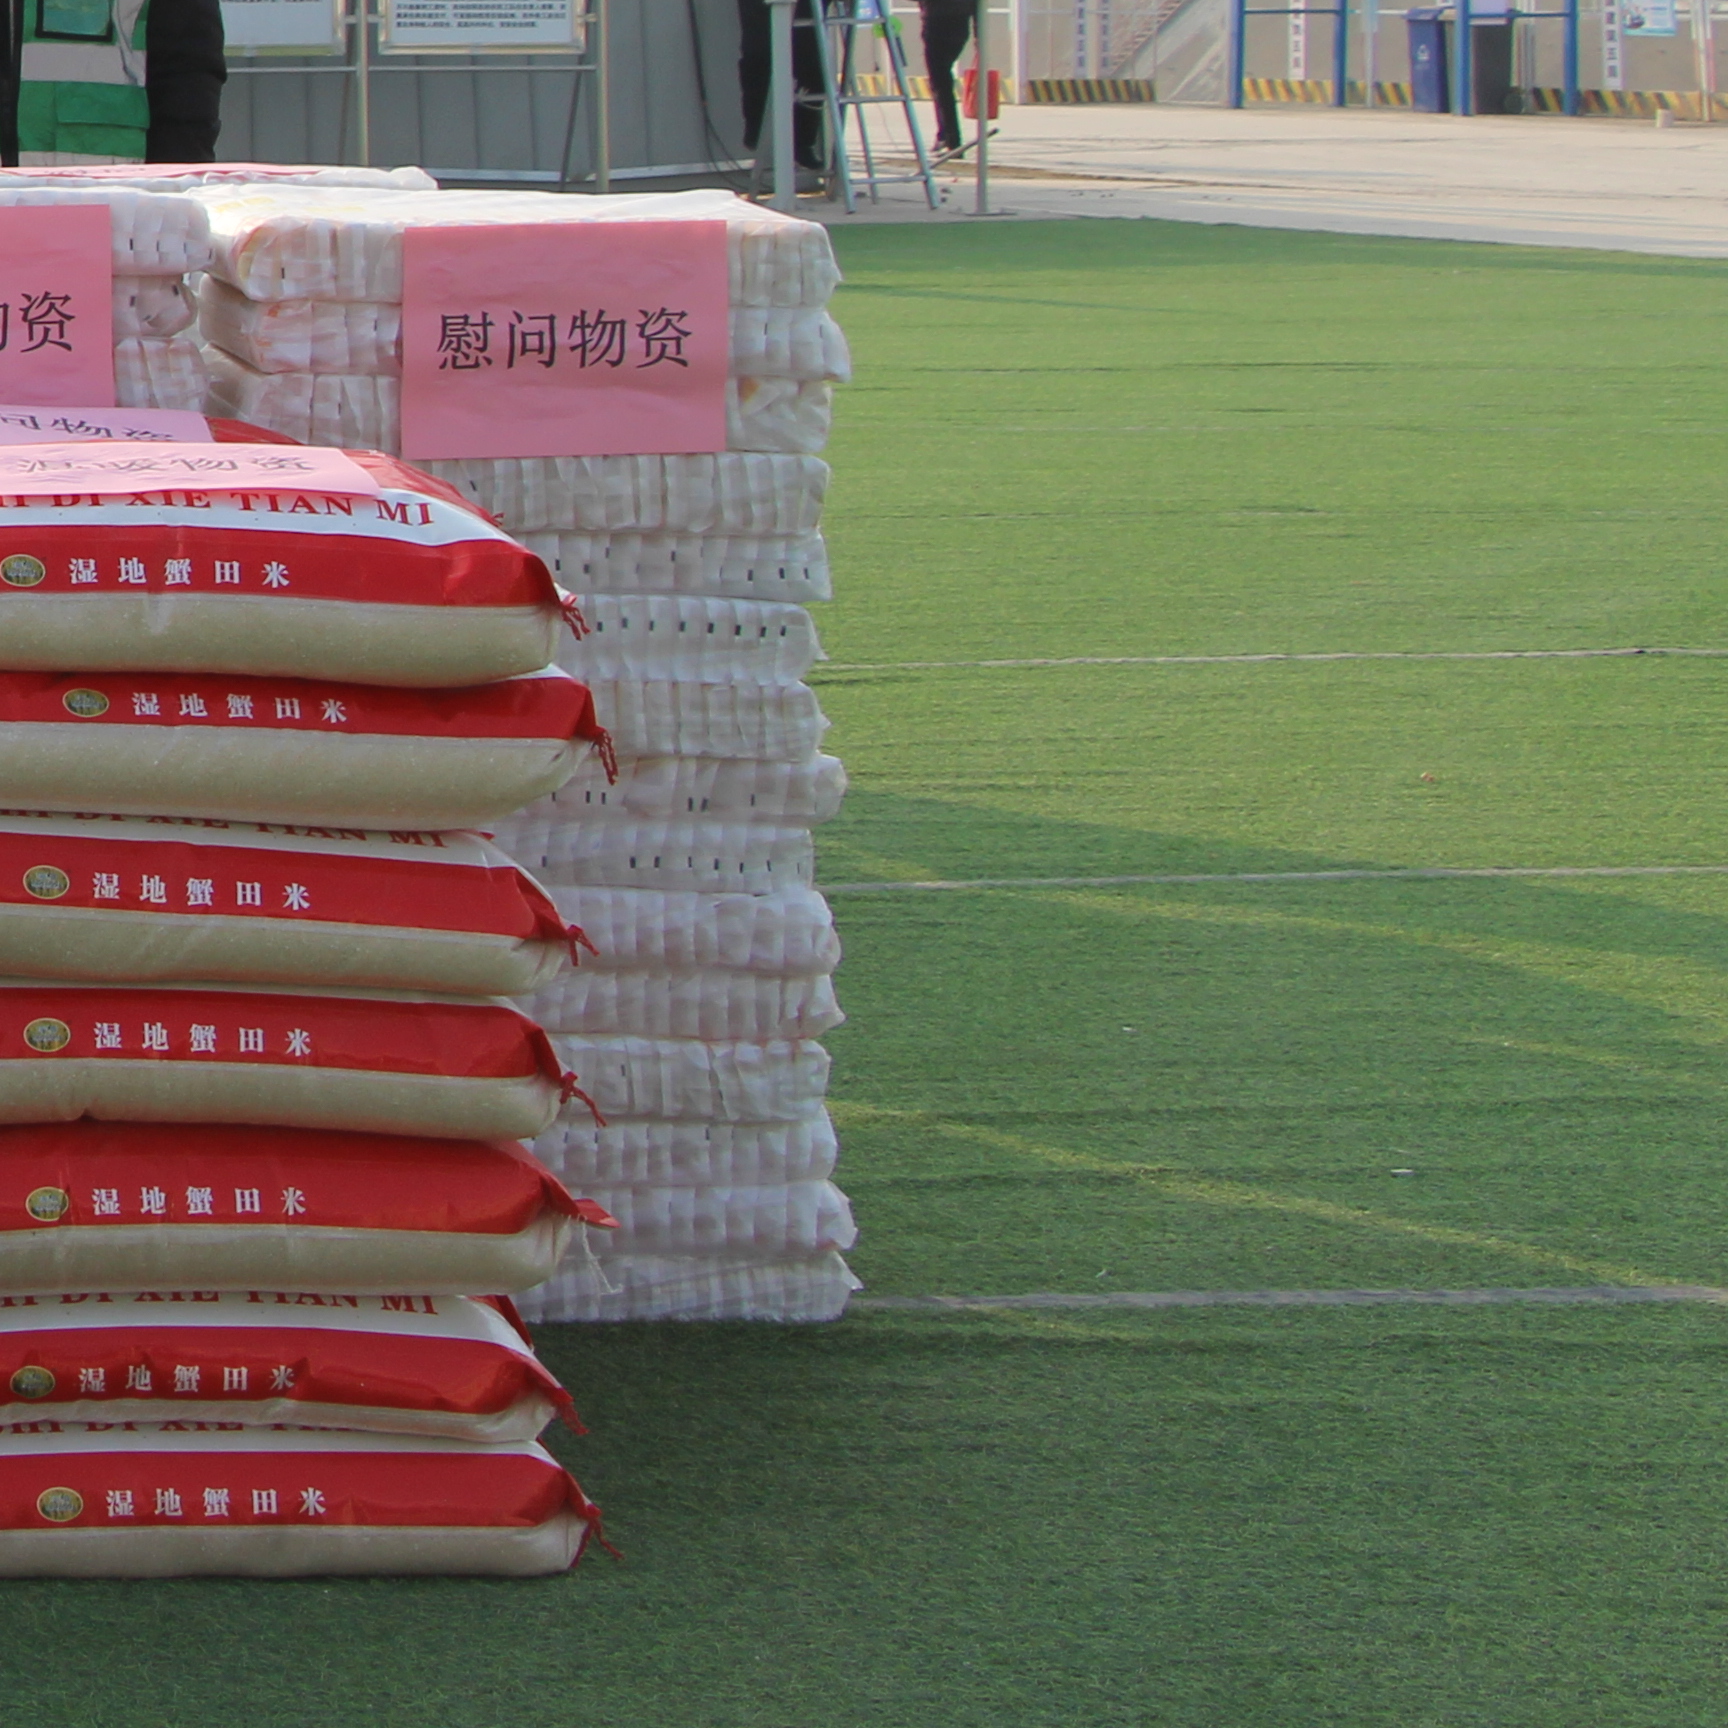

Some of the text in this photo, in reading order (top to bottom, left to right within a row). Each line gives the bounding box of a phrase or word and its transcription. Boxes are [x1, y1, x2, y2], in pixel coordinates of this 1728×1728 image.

[436, 306, 695, 372] 慰问物资
[376, 498, 435, 526] MI
[69, 557, 290, 588] 湿地蟹田米
[132, 692, 347, 723] 湿地蟹田米
[93, 872, 311, 910] 湿地蟹田米
[94, 1022, 311, 1055] 湿地蟹田米
[91, 1186, 306, 1216] 湿地蟹田米
[380, 1294, 440, 1316] MI
[79, 1364, 296, 1393] 湿地蟹田米
[105, 1486, 326, 1518] 湿地蟹田米
